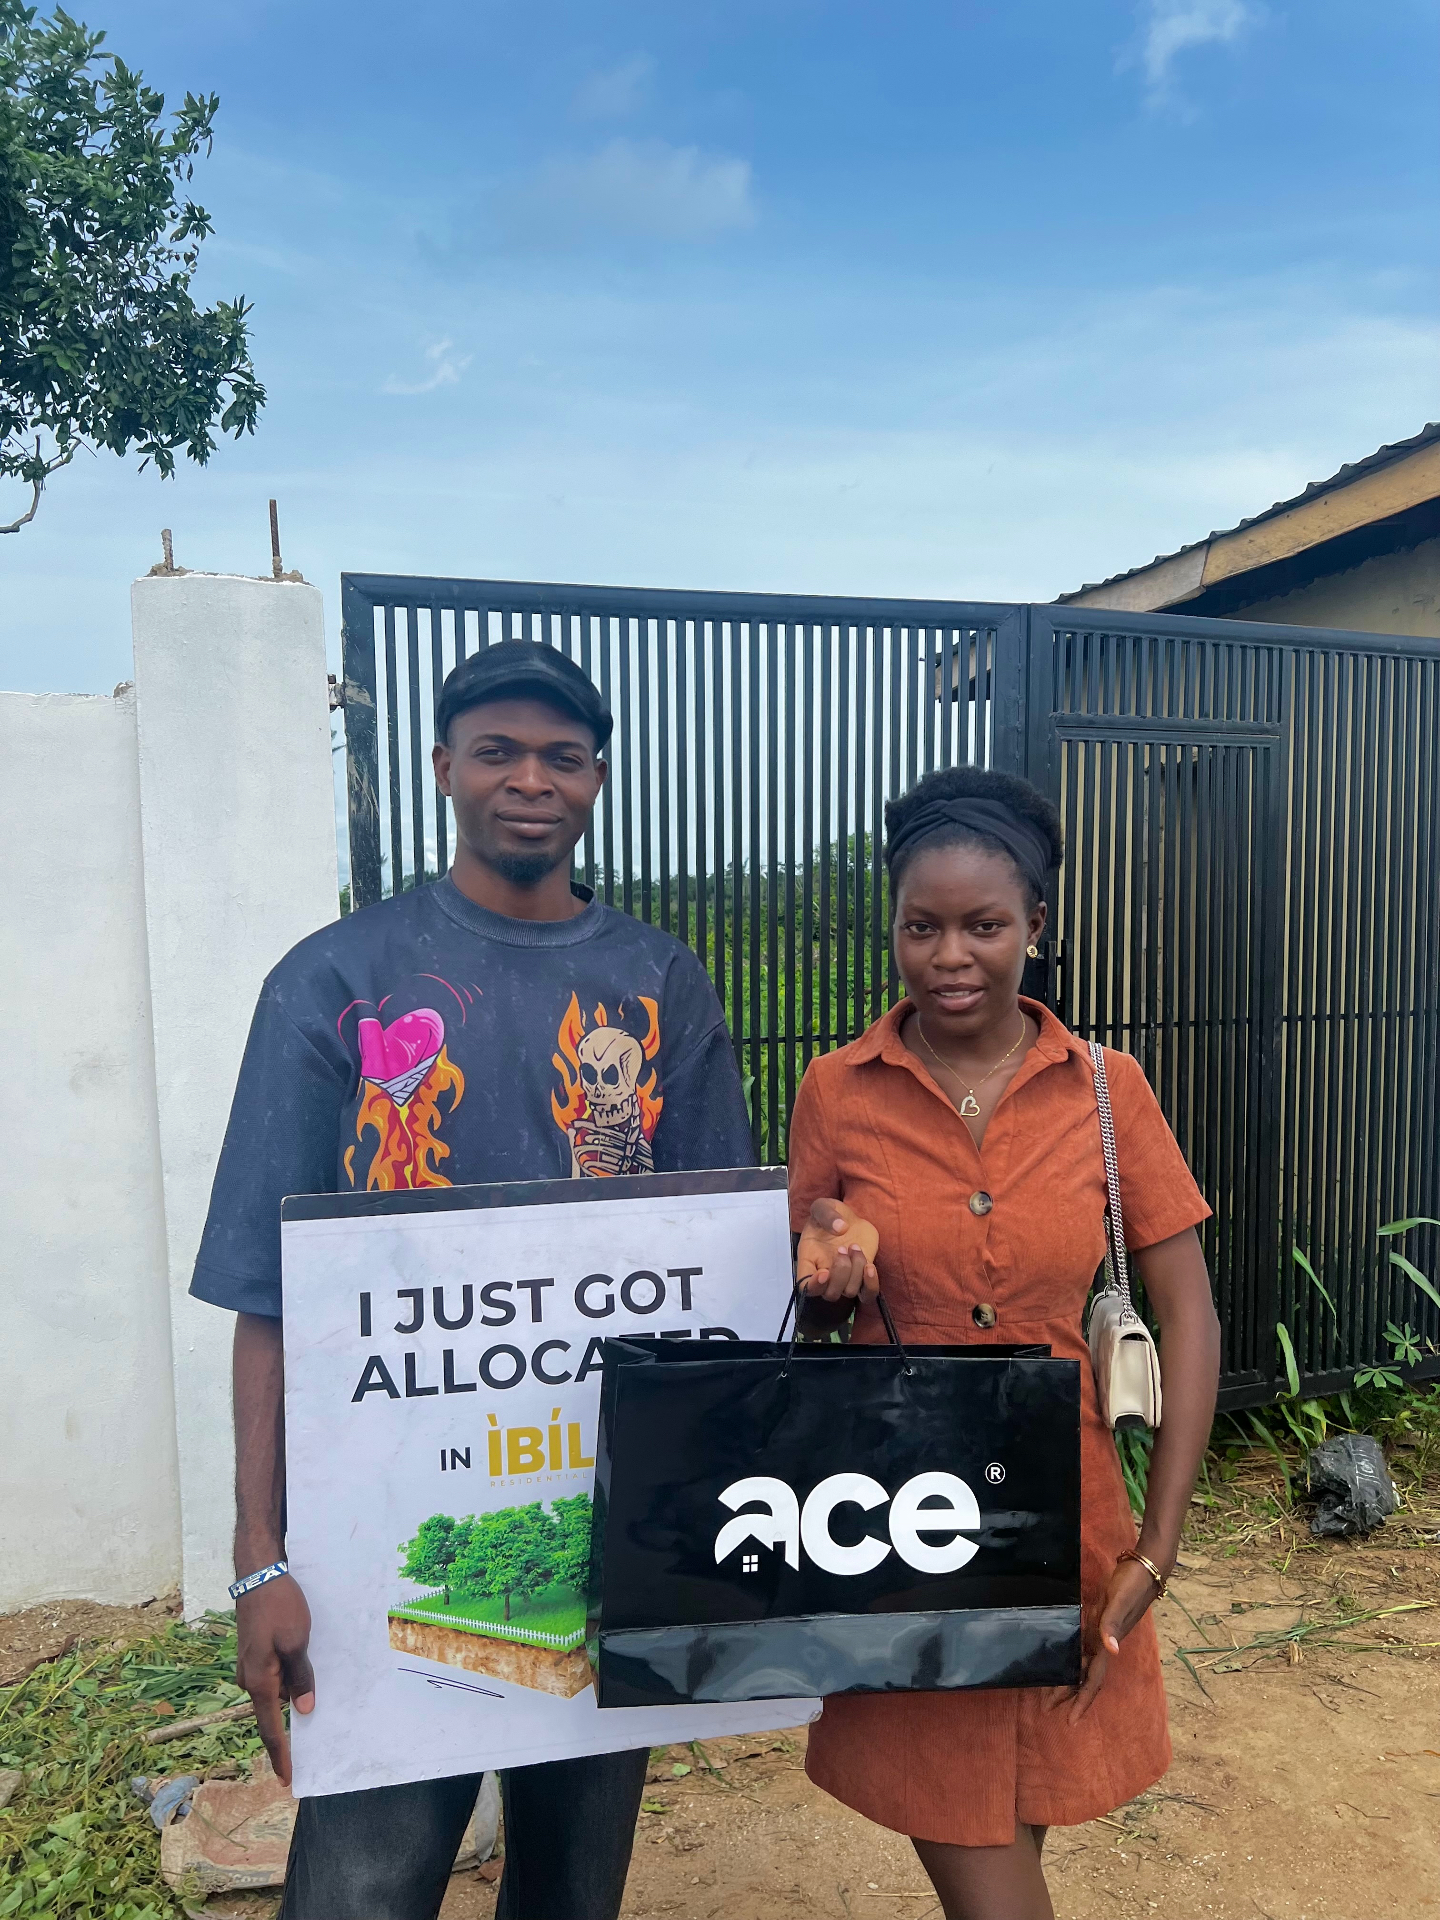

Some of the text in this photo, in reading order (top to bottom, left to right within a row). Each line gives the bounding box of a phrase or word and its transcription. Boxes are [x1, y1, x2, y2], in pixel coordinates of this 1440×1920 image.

[360, 1266, 704, 1337] I JUST GOT
[440, 1446, 472, 1472] IN
[490, 1472, 588, 1488] RESIDENTIAL
[714, 1471, 981, 1576] ace
